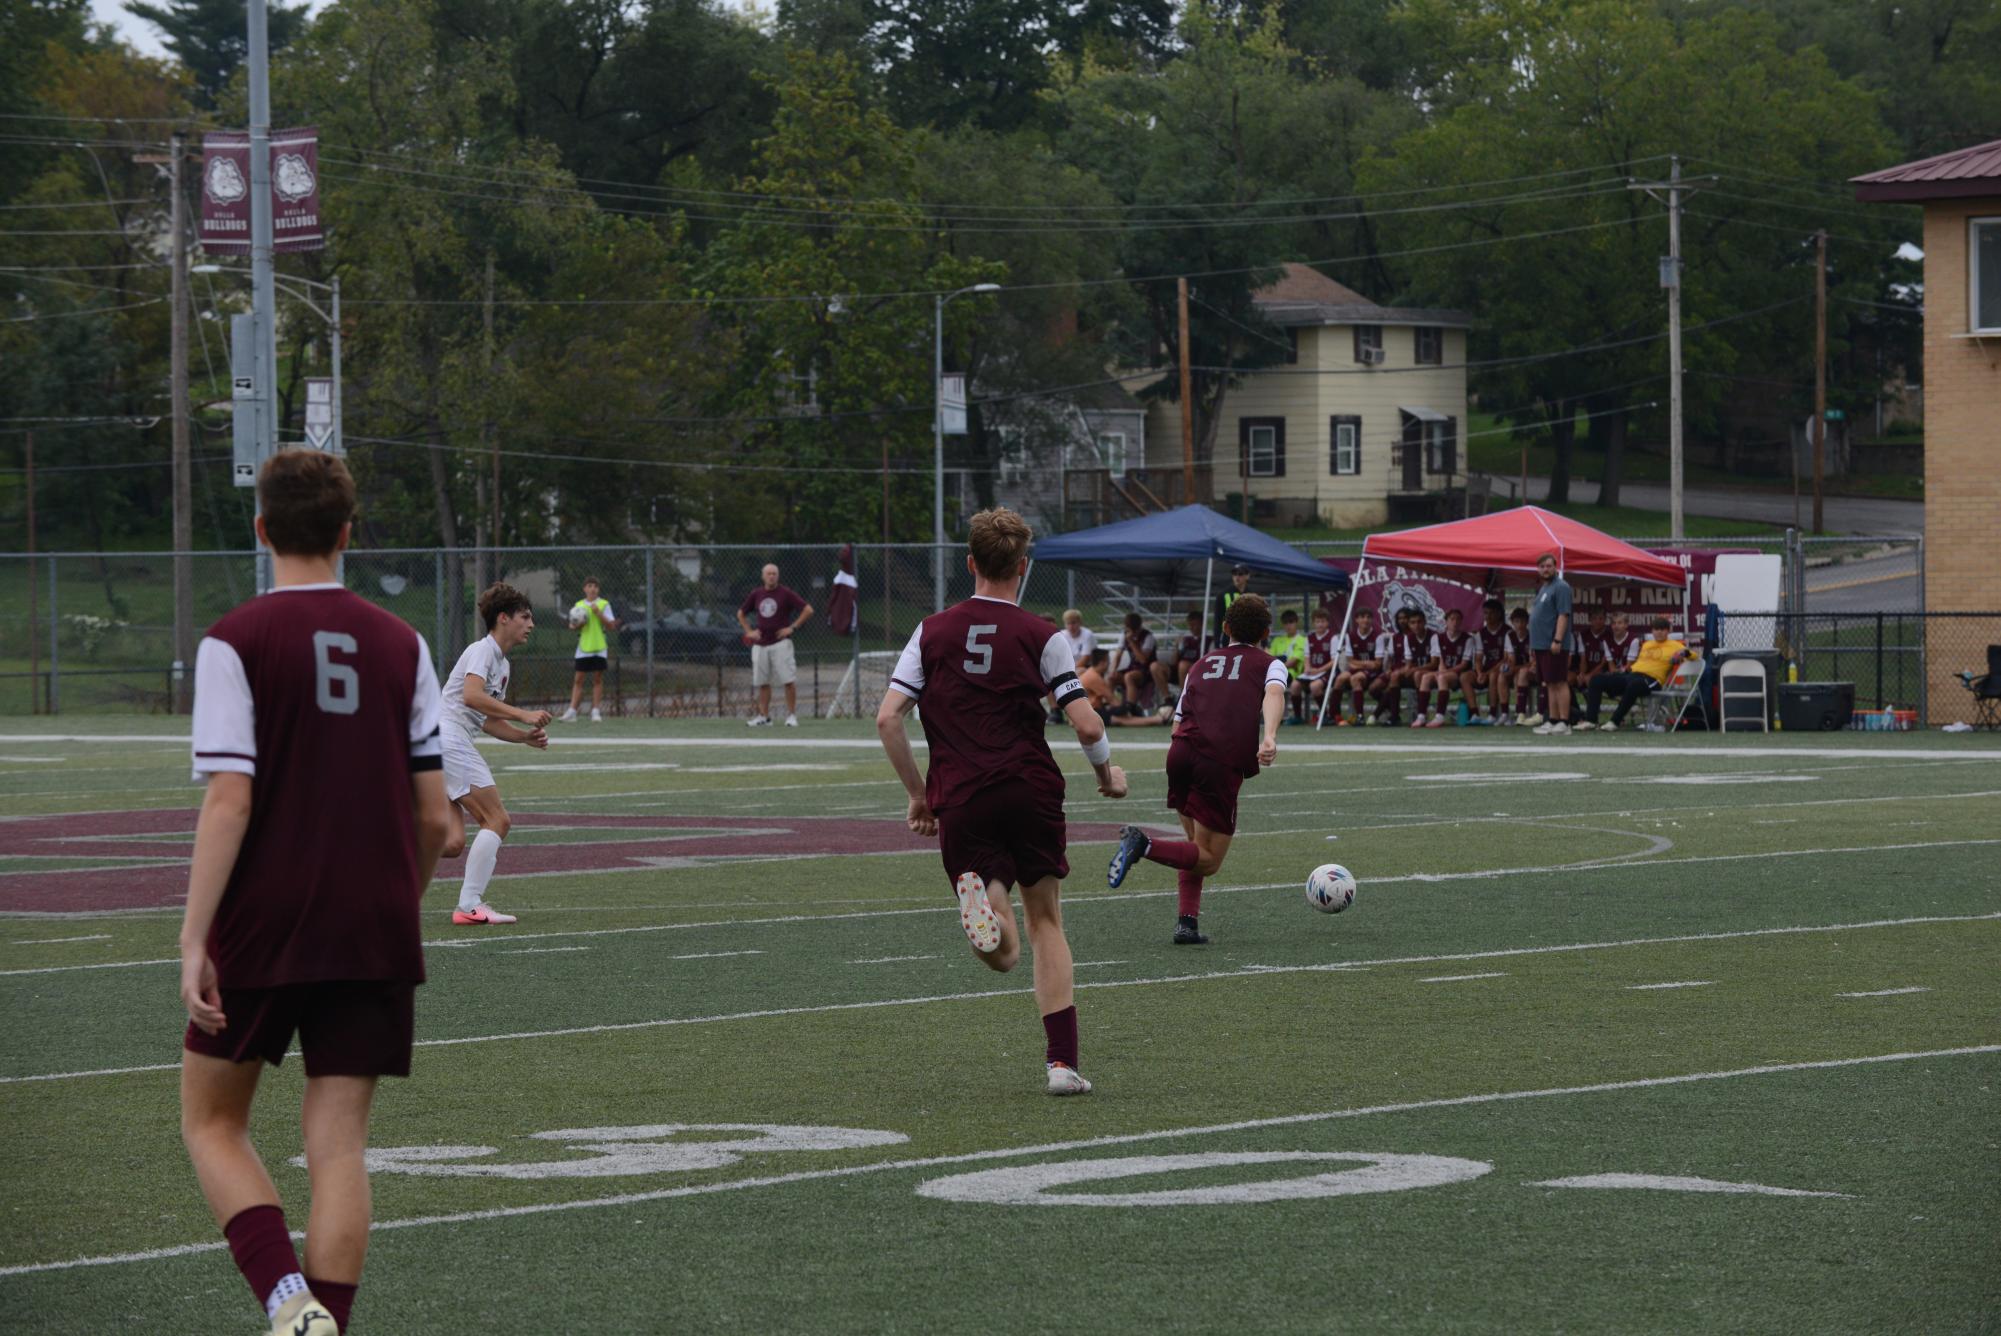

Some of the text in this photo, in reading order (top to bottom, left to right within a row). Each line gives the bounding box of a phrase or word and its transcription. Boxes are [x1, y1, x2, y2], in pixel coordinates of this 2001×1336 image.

[203, 219, 247, 230] BULLDOGS
[275, 215, 317, 229] BULLDOGS
[963, 624, 997, 675] 5
[313, 630, 360, 715] 6
[1202, 655, 1243, 681] 31
